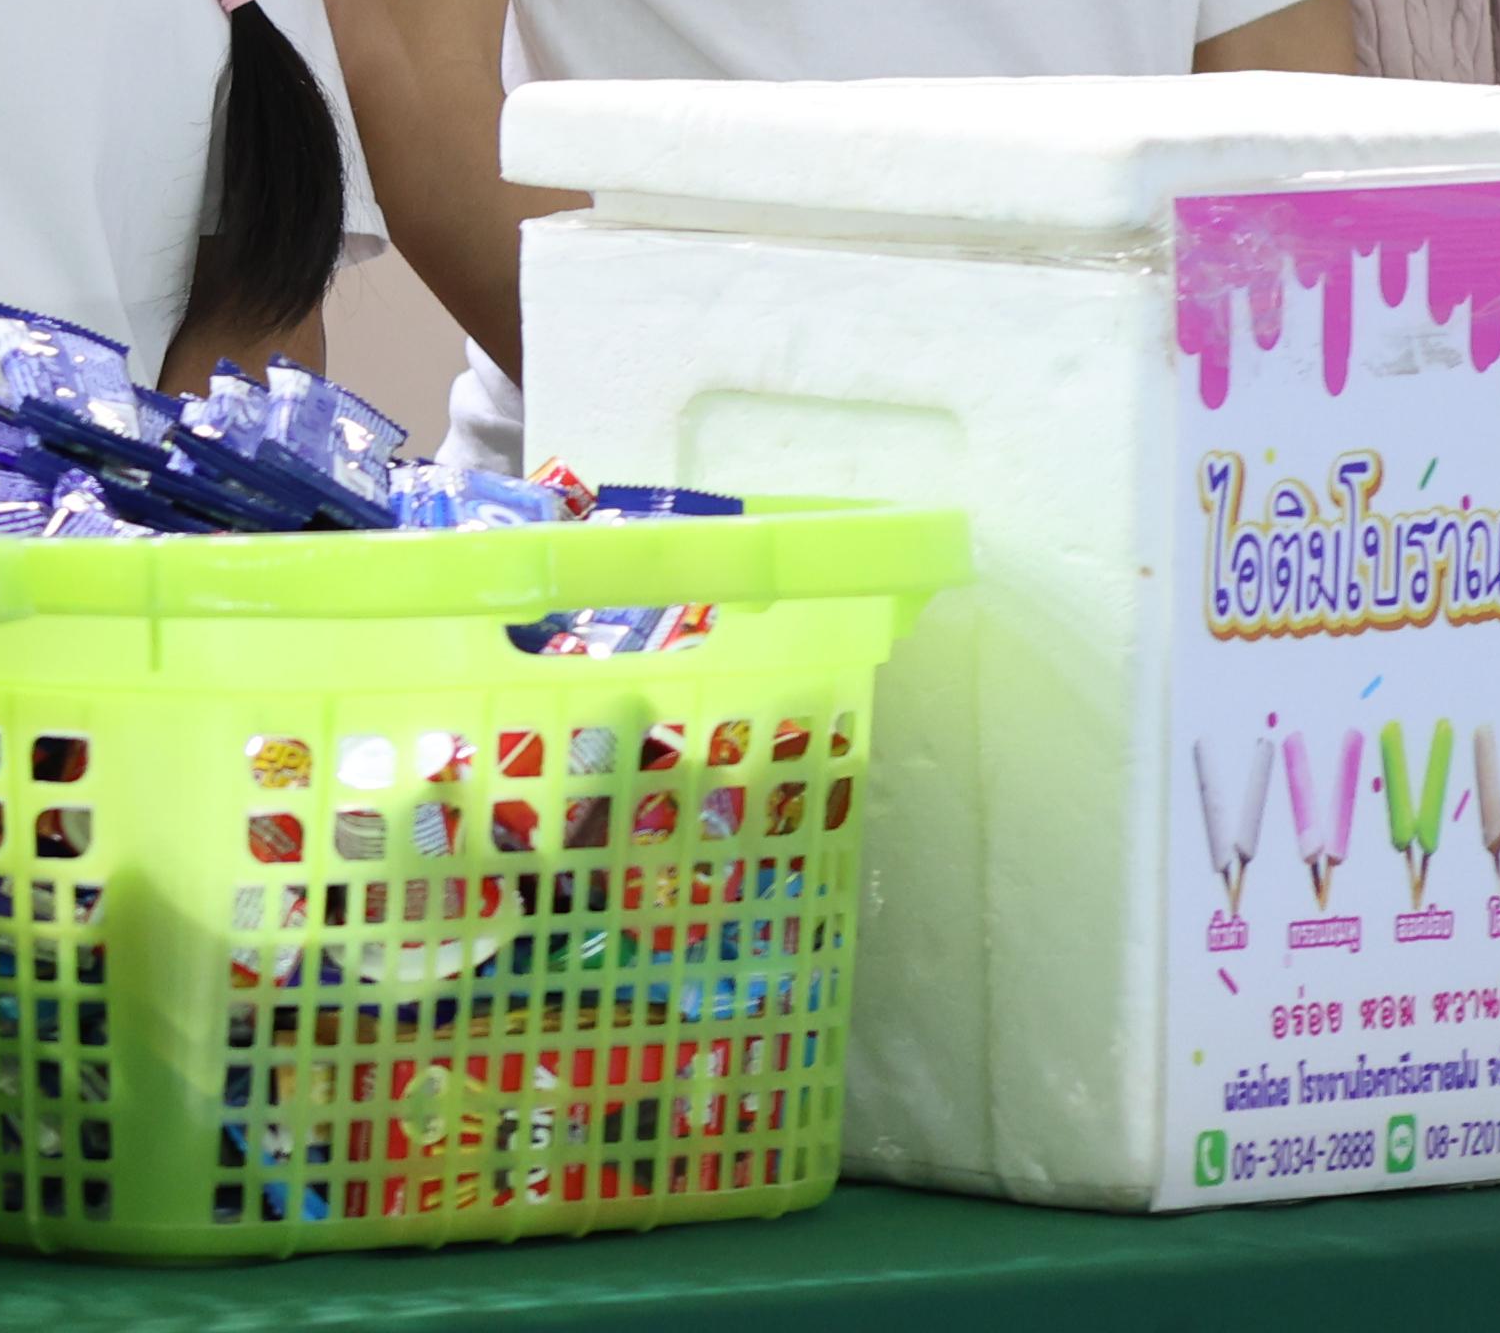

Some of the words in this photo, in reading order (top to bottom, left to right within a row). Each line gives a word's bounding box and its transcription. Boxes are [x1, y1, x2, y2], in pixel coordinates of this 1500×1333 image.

[1272, 986, 1342, 1039] อร่อย
[1361, 995, 1415, 1030] หอม
[1232, 1130, 1375, 1181] 06-3034-2888
